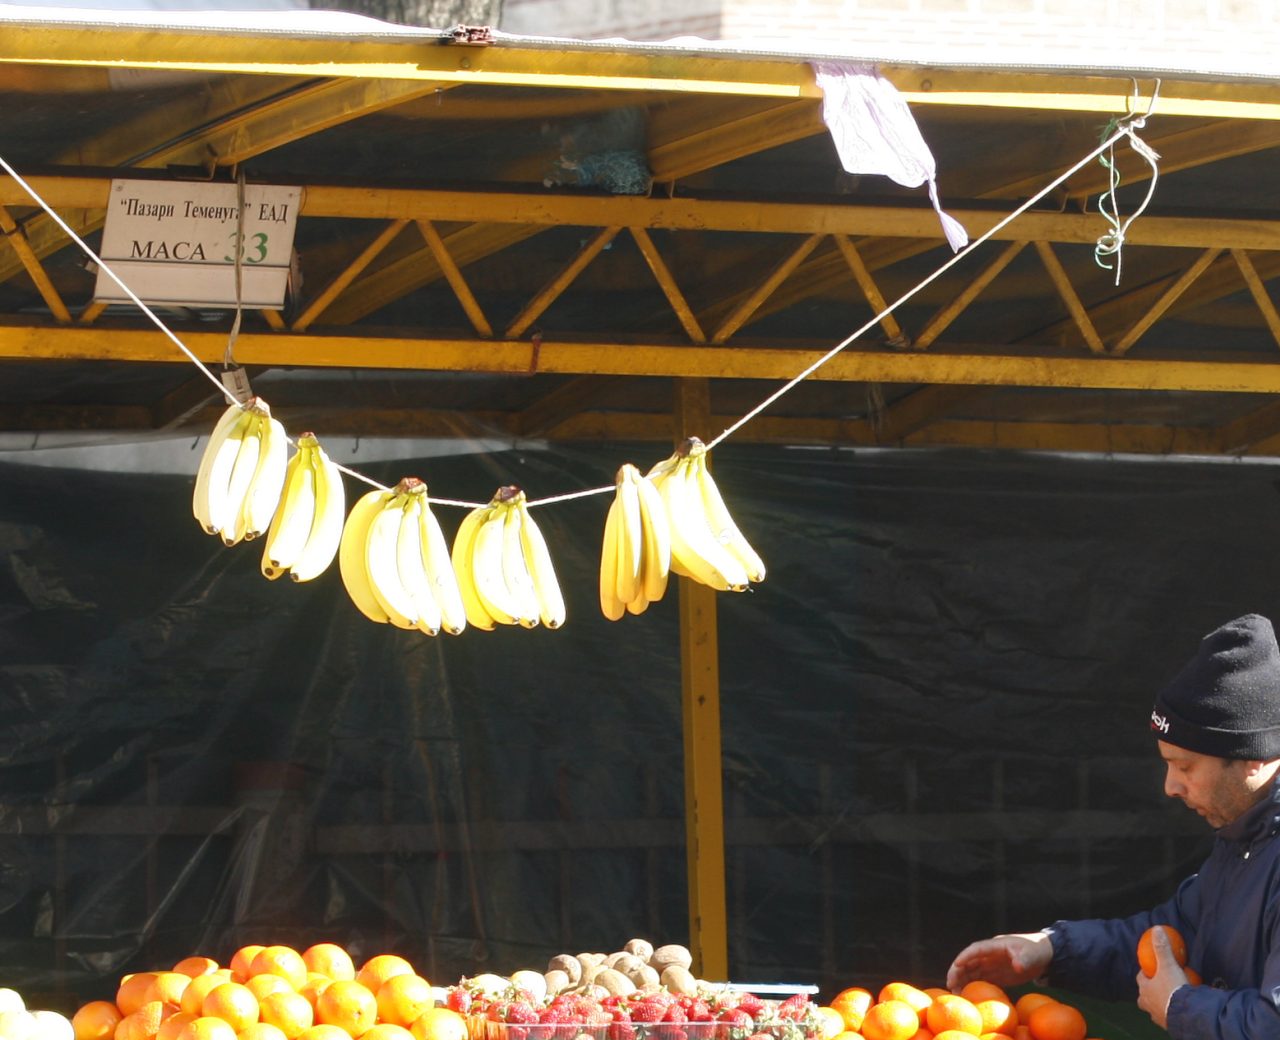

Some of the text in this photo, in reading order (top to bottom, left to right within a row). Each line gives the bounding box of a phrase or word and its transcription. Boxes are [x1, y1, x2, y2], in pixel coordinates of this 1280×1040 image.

[258, 203, 289, 224] ЕАД
[130, 231, 269, 263] МАСА 33
